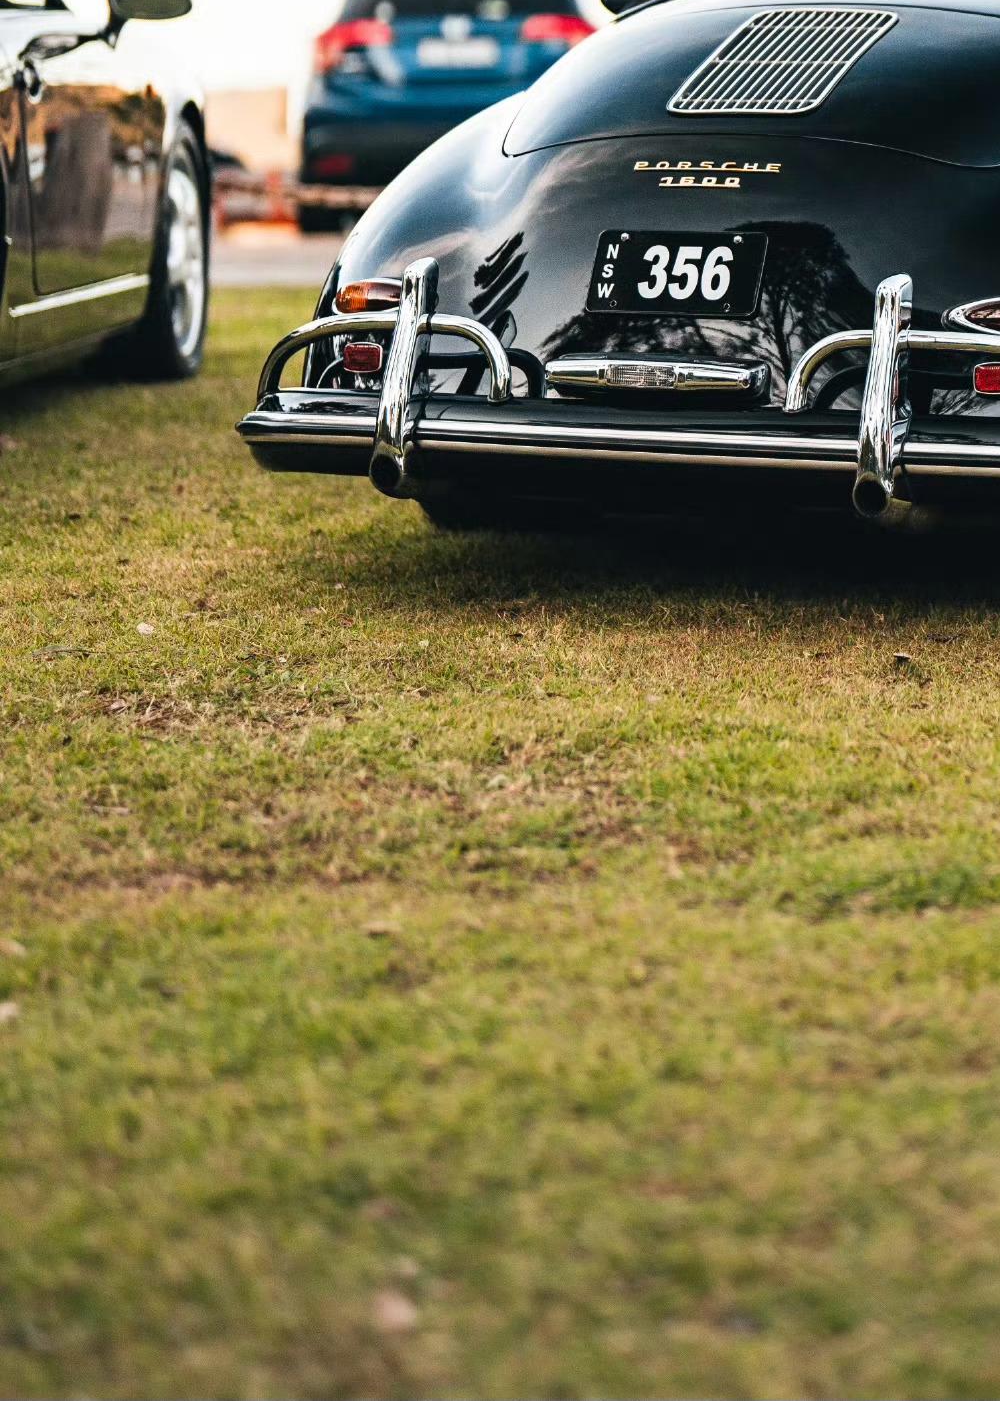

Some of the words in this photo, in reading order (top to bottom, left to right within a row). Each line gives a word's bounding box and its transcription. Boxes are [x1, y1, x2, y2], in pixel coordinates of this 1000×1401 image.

[634, 161, 782, 173] PORSCHE
[659, 176, 741, 188] 1600
[637, 244, 734, 301] 356
